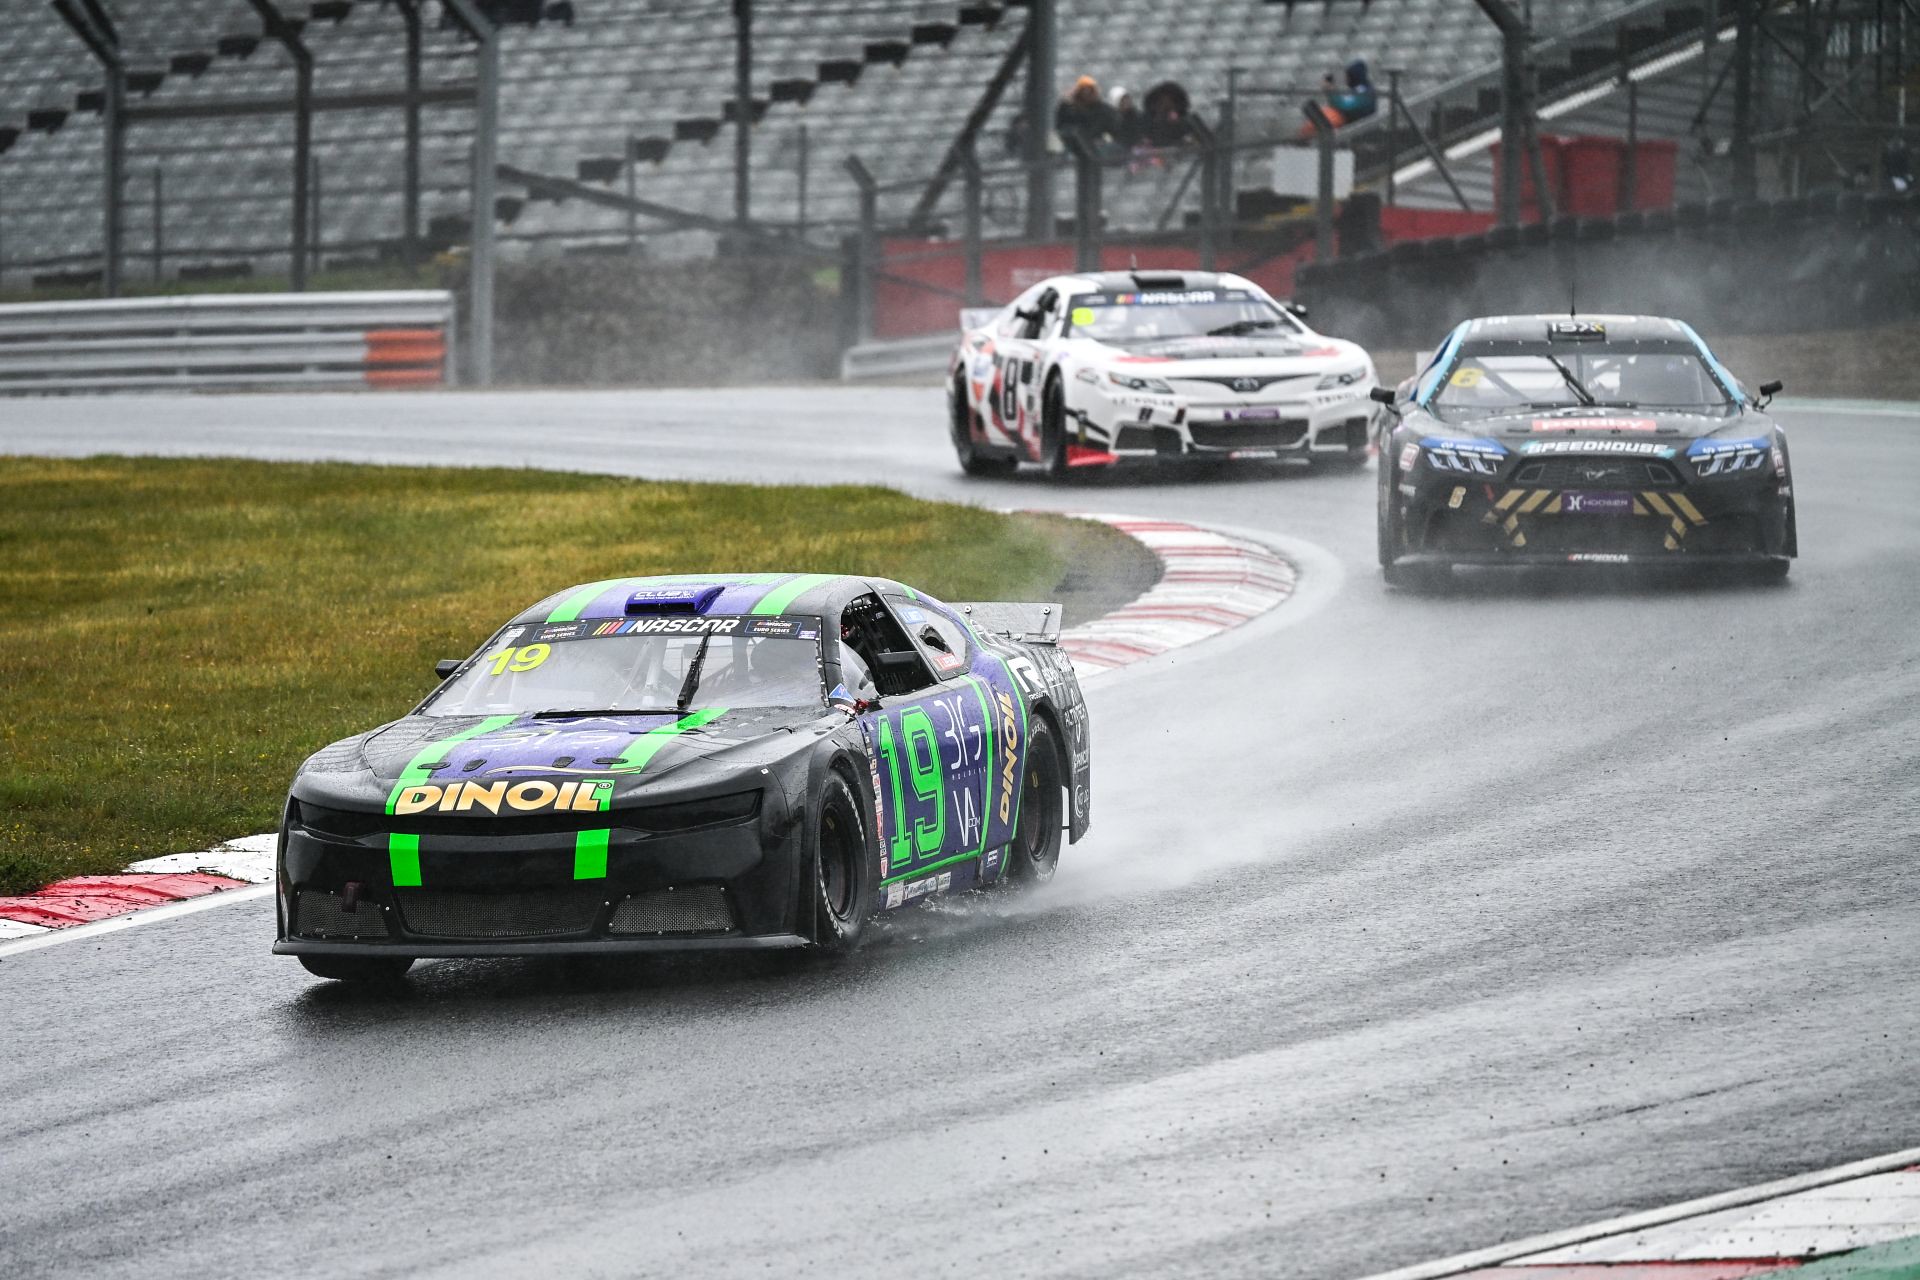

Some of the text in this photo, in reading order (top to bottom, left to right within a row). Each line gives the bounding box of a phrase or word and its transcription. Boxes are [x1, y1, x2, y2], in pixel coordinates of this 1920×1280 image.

[1003, 357, 1018, 421] 8
[1527, 440, 1669, 455] SPEEDHOUSE
[627, 619, 740, 635] NASCAR
[487, 643, 551, 676] 19
[997, 691, 1018, 827] DINOIL
[395, 780, 601, 816] DINOIL
[878, 705, 946, 869] 19
